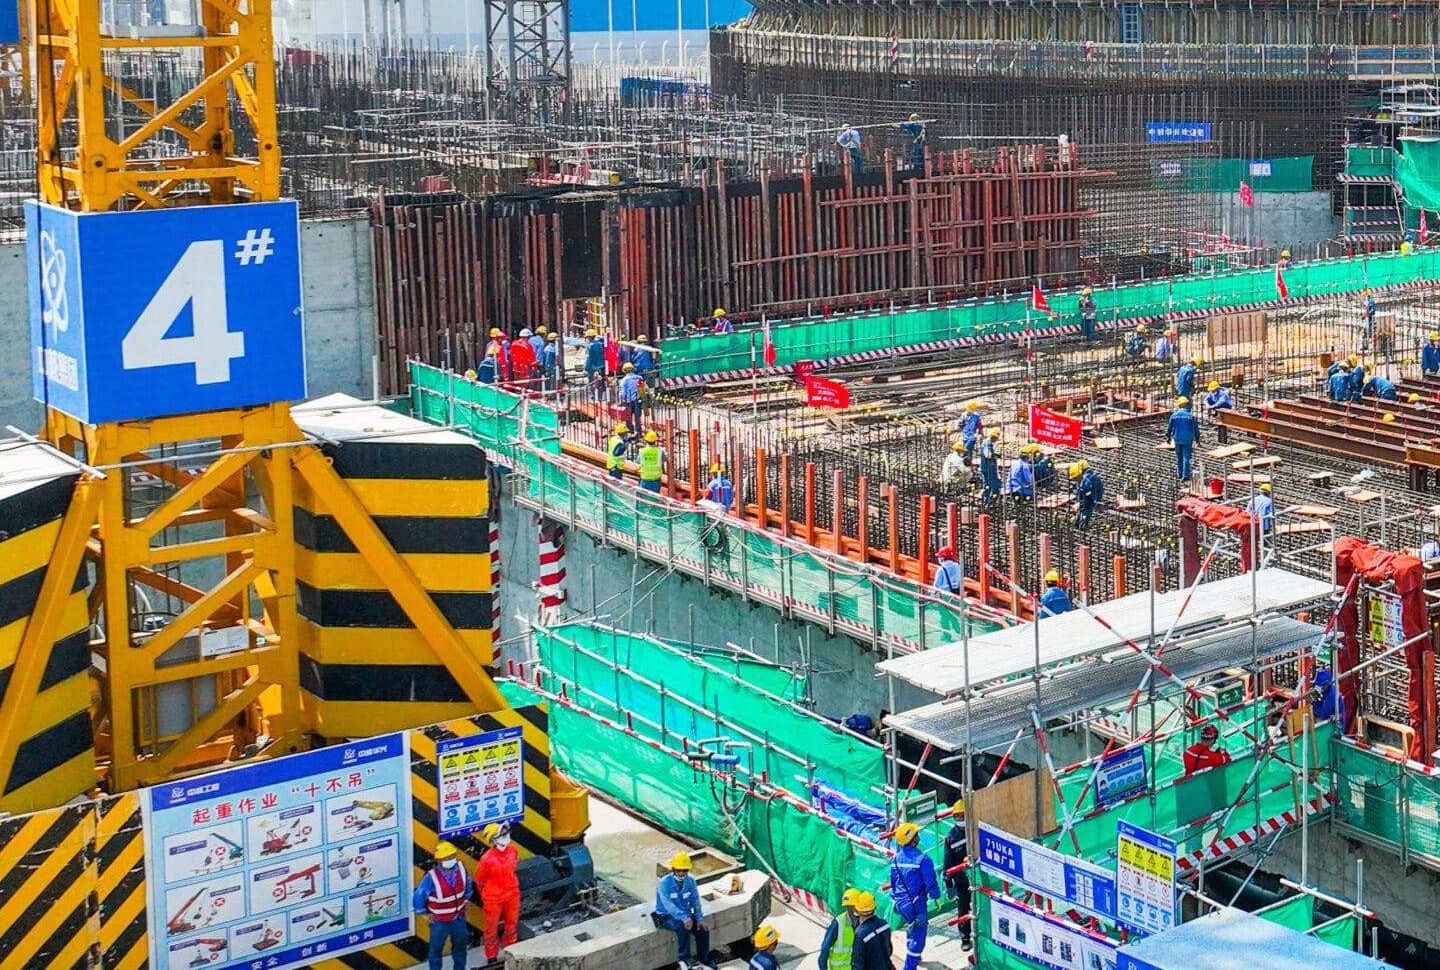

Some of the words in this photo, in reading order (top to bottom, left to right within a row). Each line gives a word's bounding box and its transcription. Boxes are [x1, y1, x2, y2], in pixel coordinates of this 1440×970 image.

[192, 793, 278, 825] 起重作业
[985, 838, 1014, 858] 71UKA
